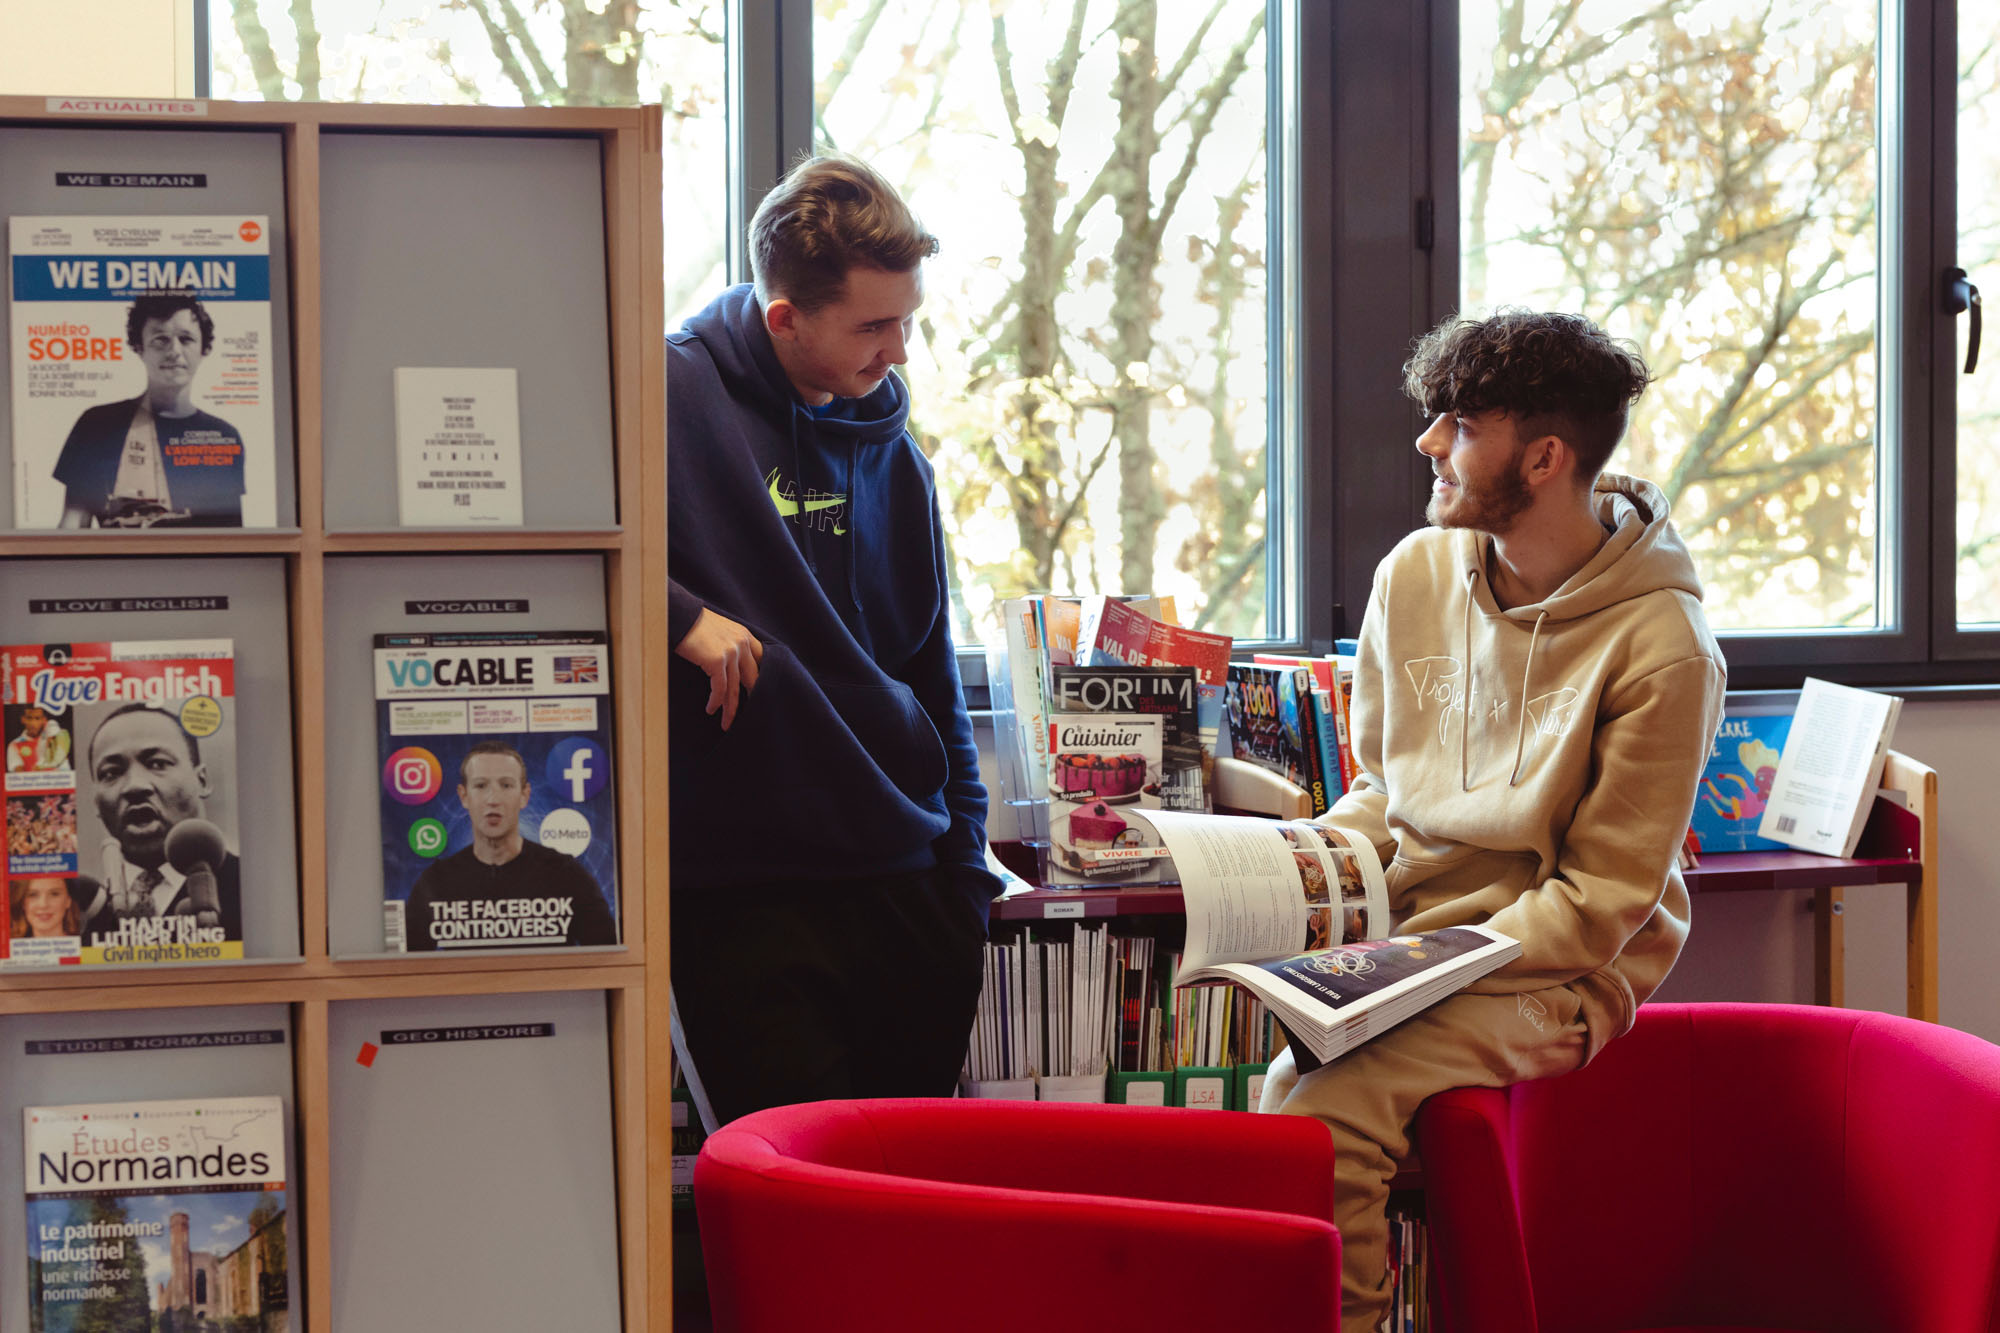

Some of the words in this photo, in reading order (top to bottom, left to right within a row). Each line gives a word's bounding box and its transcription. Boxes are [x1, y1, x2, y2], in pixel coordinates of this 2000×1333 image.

[67, 175, 102, 185] WE
[110, 175, 195, 186] DEMAIN
[48, 261, 99, 289] WE
[106, 261, 236, 289] DEMAIN
[27, 323, 90, 336] NUMÉRO
[28, 338, 123, 360] SOBRE
[42, 603, 47, 611] I
[56, 601, 114, 611] LOVE
[121, 599, 216, 610] ENGLISH
[416, 602, 518, 613] VOCABLE
[1103, 635, 1125, 661] VAL
[1128, 648, 1148, 667] DE
[387, 657, 534, 687] VOCABLE
[16, 675, 27, 704] I
[32, 670, 101, 714] Love
[106, 666, 222, 708] English
[1062, 728, 1142, 747] Cuisinier
[1312, 781, 1325, 811] 1000
[558, 829, 589, 839] Meta
[1103, 850, 1142, 858] VIVRE
[429, 901, 469, 921] THE
[472, 897, 574, 919] FACEBOOK
[119, 914, 197, 934] MARTIN
[429, 917, 572, 940] CONTROVERSY
[177, 926, 225, 944] KING
[103, 946, 135, 963] Civil
[137, 944, 182, 963] rights
[185, 942, 221, 959] hero
[37, 1040, 126, 1053] ETUDES
[133, 1033, 273, 1049] NORMANDES
[393, 1031, 438, 1042] GEO
[446, 1026, 543, 1040] HISTOIRE
[1192, 1089, 1216, 1104] LSA
[72, 1126, 171, 1156] Études
[40, 1145, 270, 1185] Normandes
[40, 1224, 62, 1241] Le
[64, 1220, 164, 1242] patrimoine
[41, 1242, 124, 1263] industriel
[42, 1271, 69, 1284] une
[74, 1267, 131, 1283] richesse
[43, 1285, 116, 1301] normande
